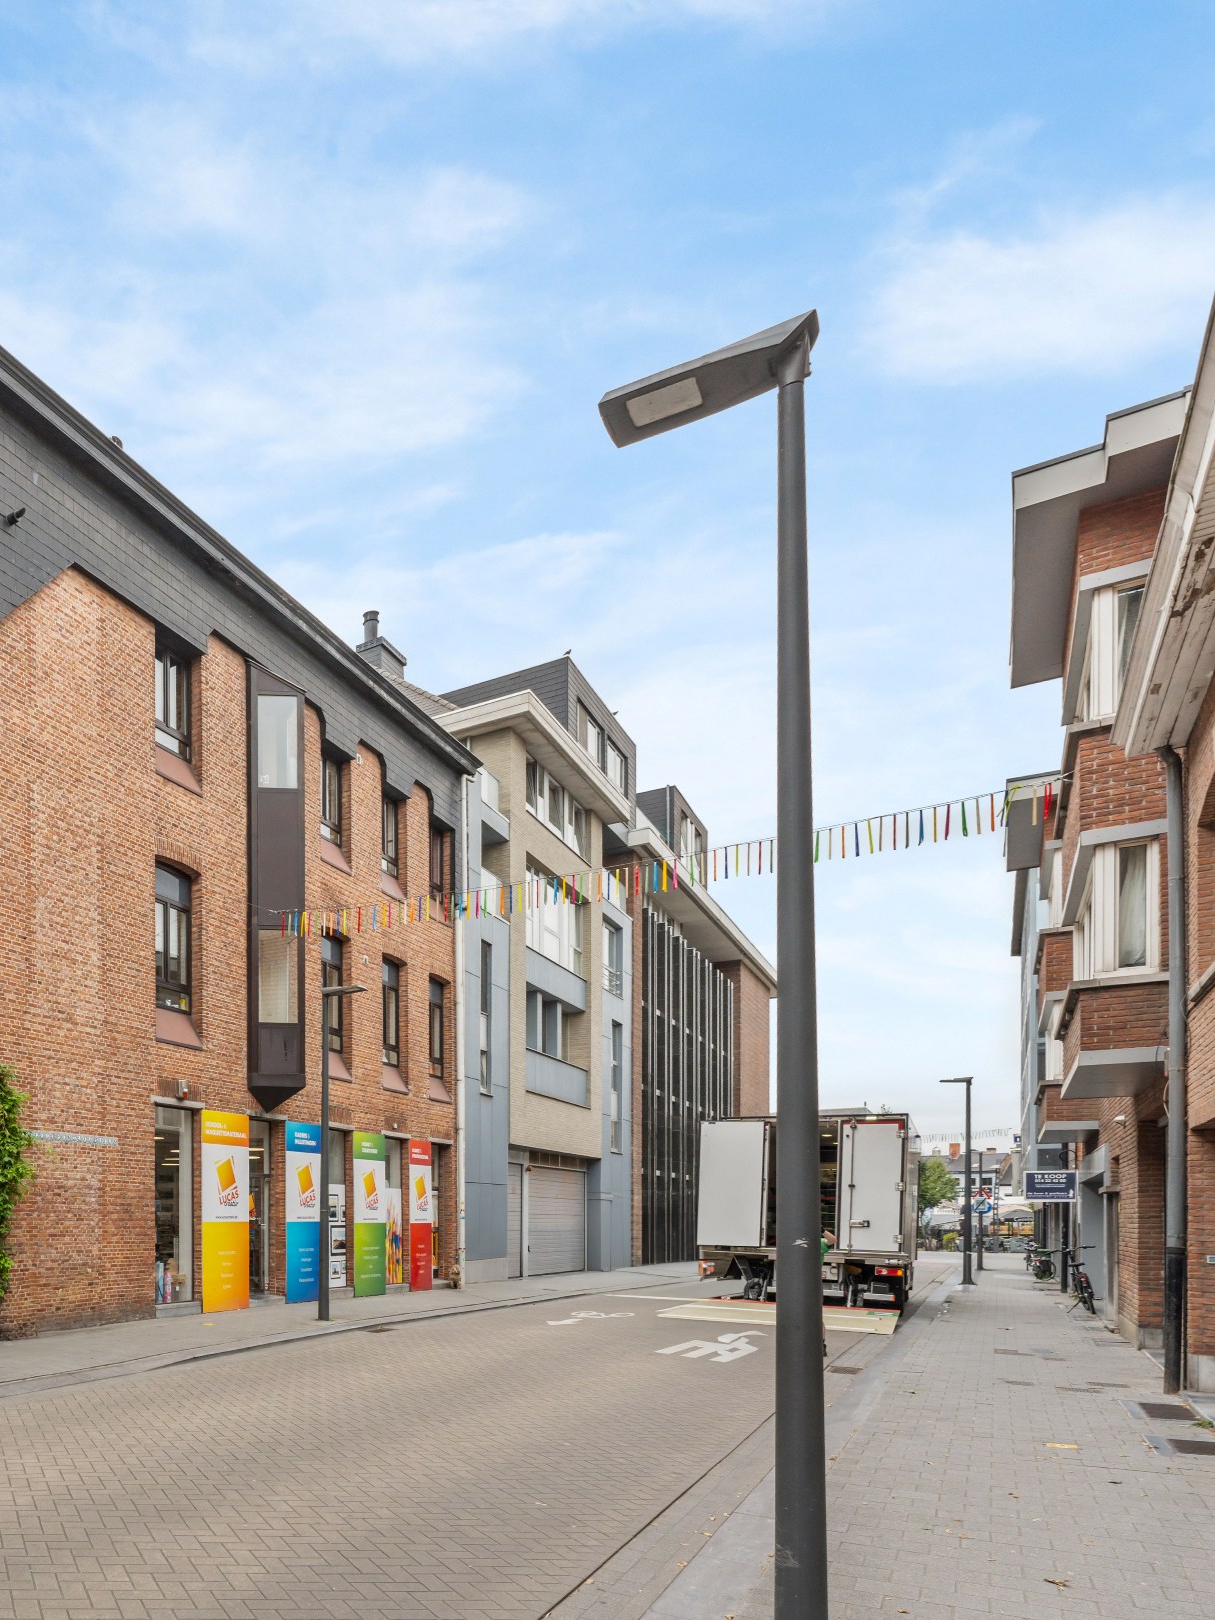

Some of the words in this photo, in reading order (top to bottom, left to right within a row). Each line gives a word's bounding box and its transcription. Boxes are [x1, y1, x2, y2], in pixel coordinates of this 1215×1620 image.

[218, 1189, 239, 1205] LUCAS
[299, 1192, 316, 1207] LUCAS
[364, 1196, 379, 1209] LUCAS
[416, 1198, 429, 1211] LUCAS
